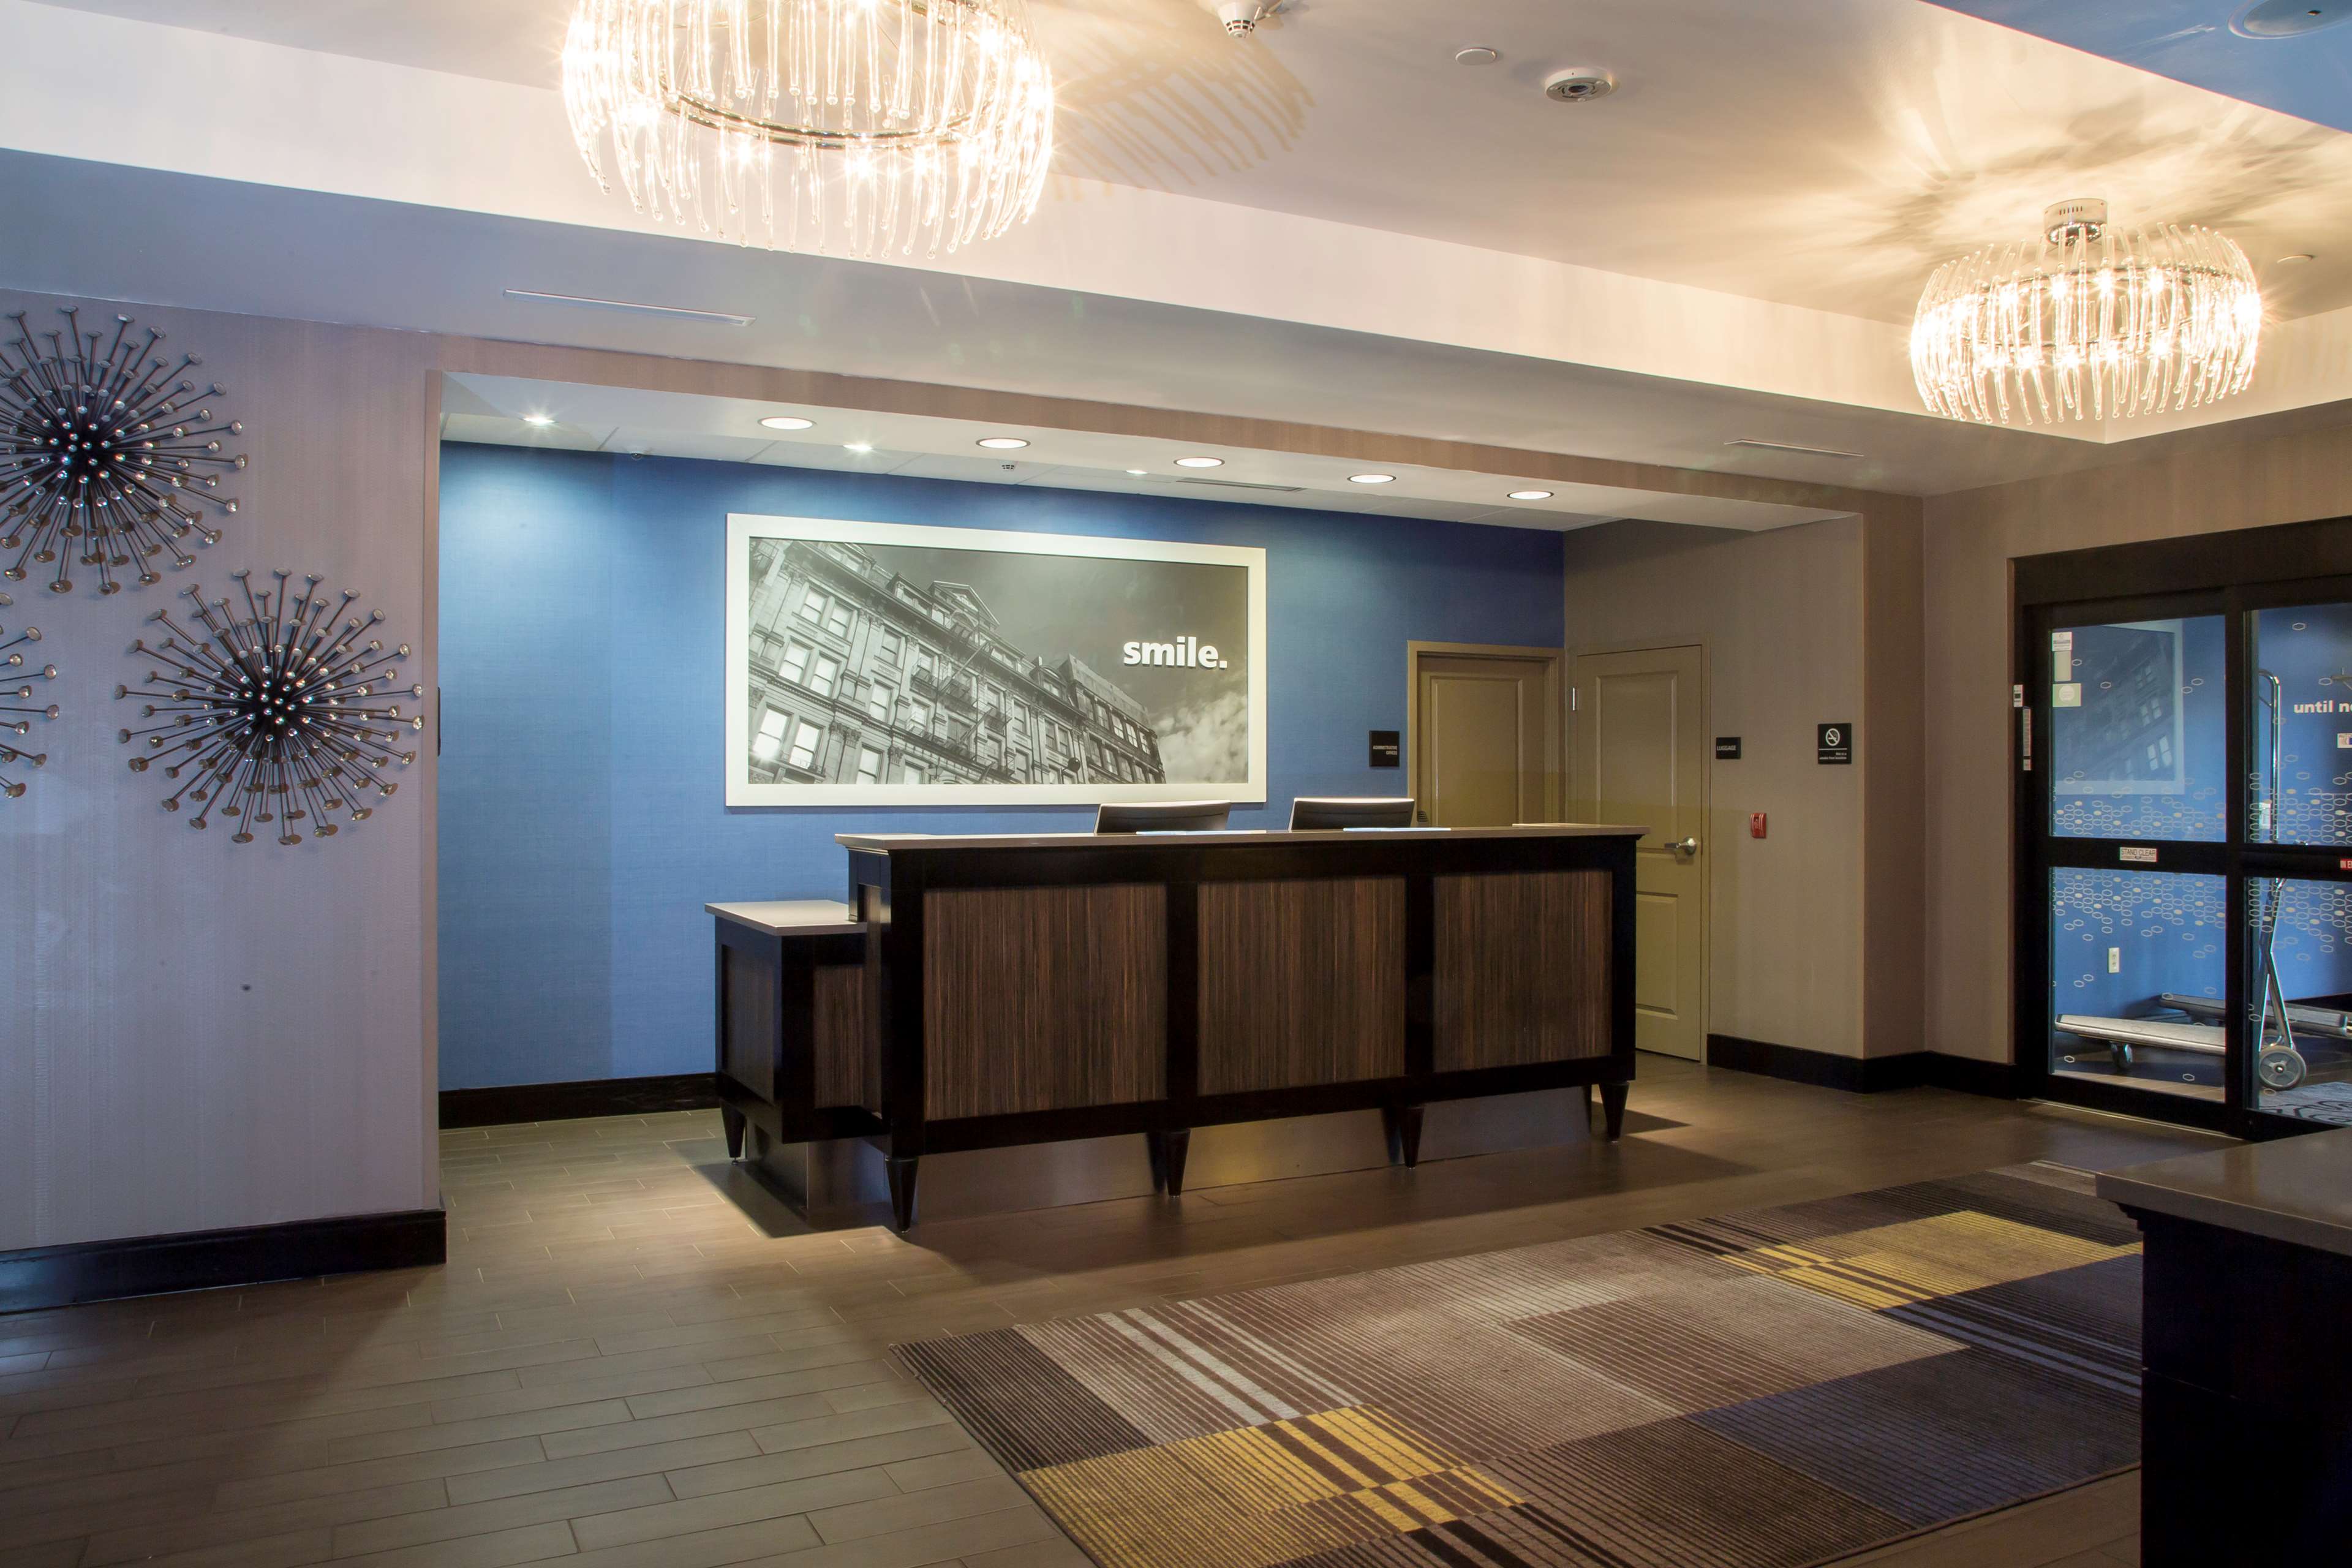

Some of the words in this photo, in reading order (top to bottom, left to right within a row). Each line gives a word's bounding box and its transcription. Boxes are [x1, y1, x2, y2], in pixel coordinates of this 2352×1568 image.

[1123, 636, 1227, 669] smile.
[2293, 700, 2333, 713] until
[2339, 703, 2352, 713] n
